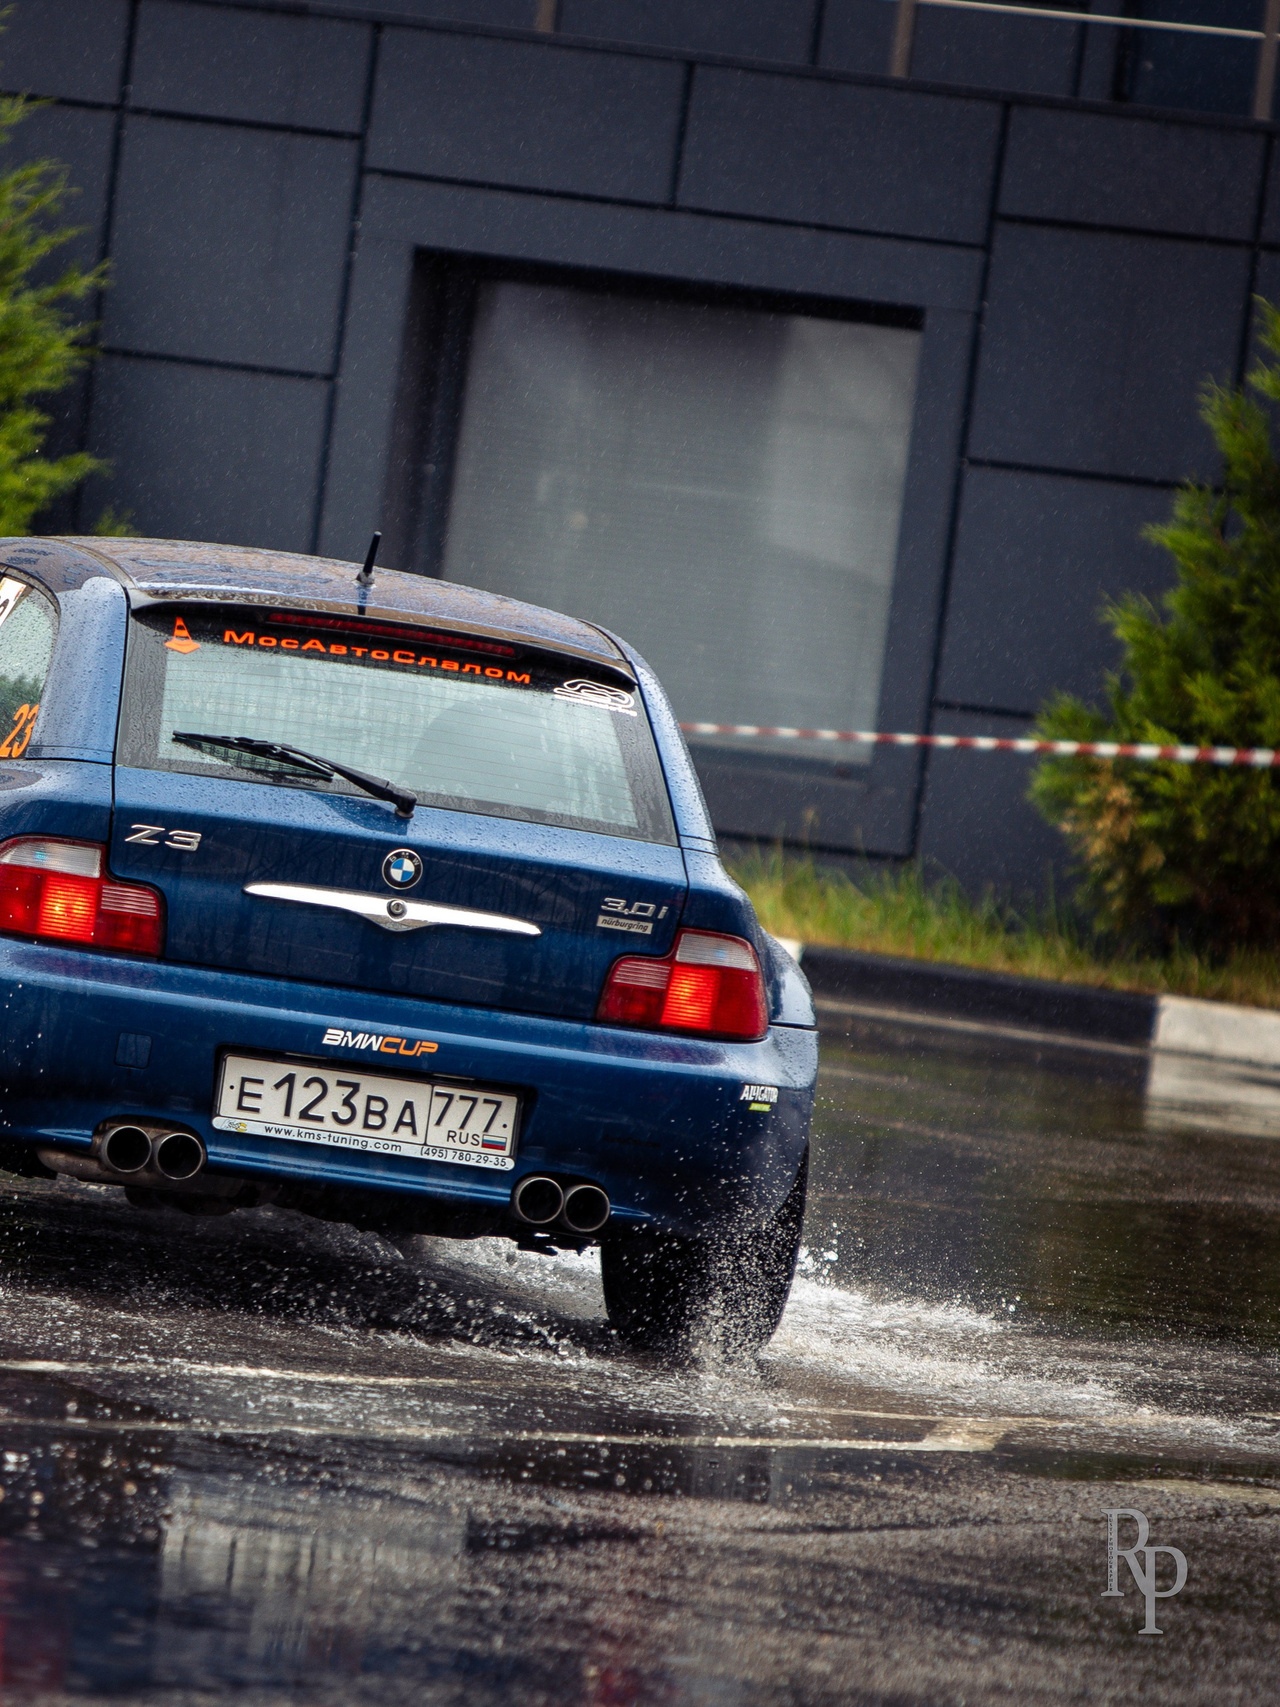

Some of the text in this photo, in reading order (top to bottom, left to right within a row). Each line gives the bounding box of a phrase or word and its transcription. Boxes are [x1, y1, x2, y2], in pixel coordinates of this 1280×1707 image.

[223, 630, 531, 685] МосАвтоСлалом
[124, 823, 203, 852] Z3
[434, 1091, 504, 1133] 777
[264, 1125, 403, 1153] www.kms-tuning.com
[419, 1146, 448, 1160] (495)
[451, 1150, 508, 1168] 780-29-35
[446, 1129, 481, 1147] RUS
